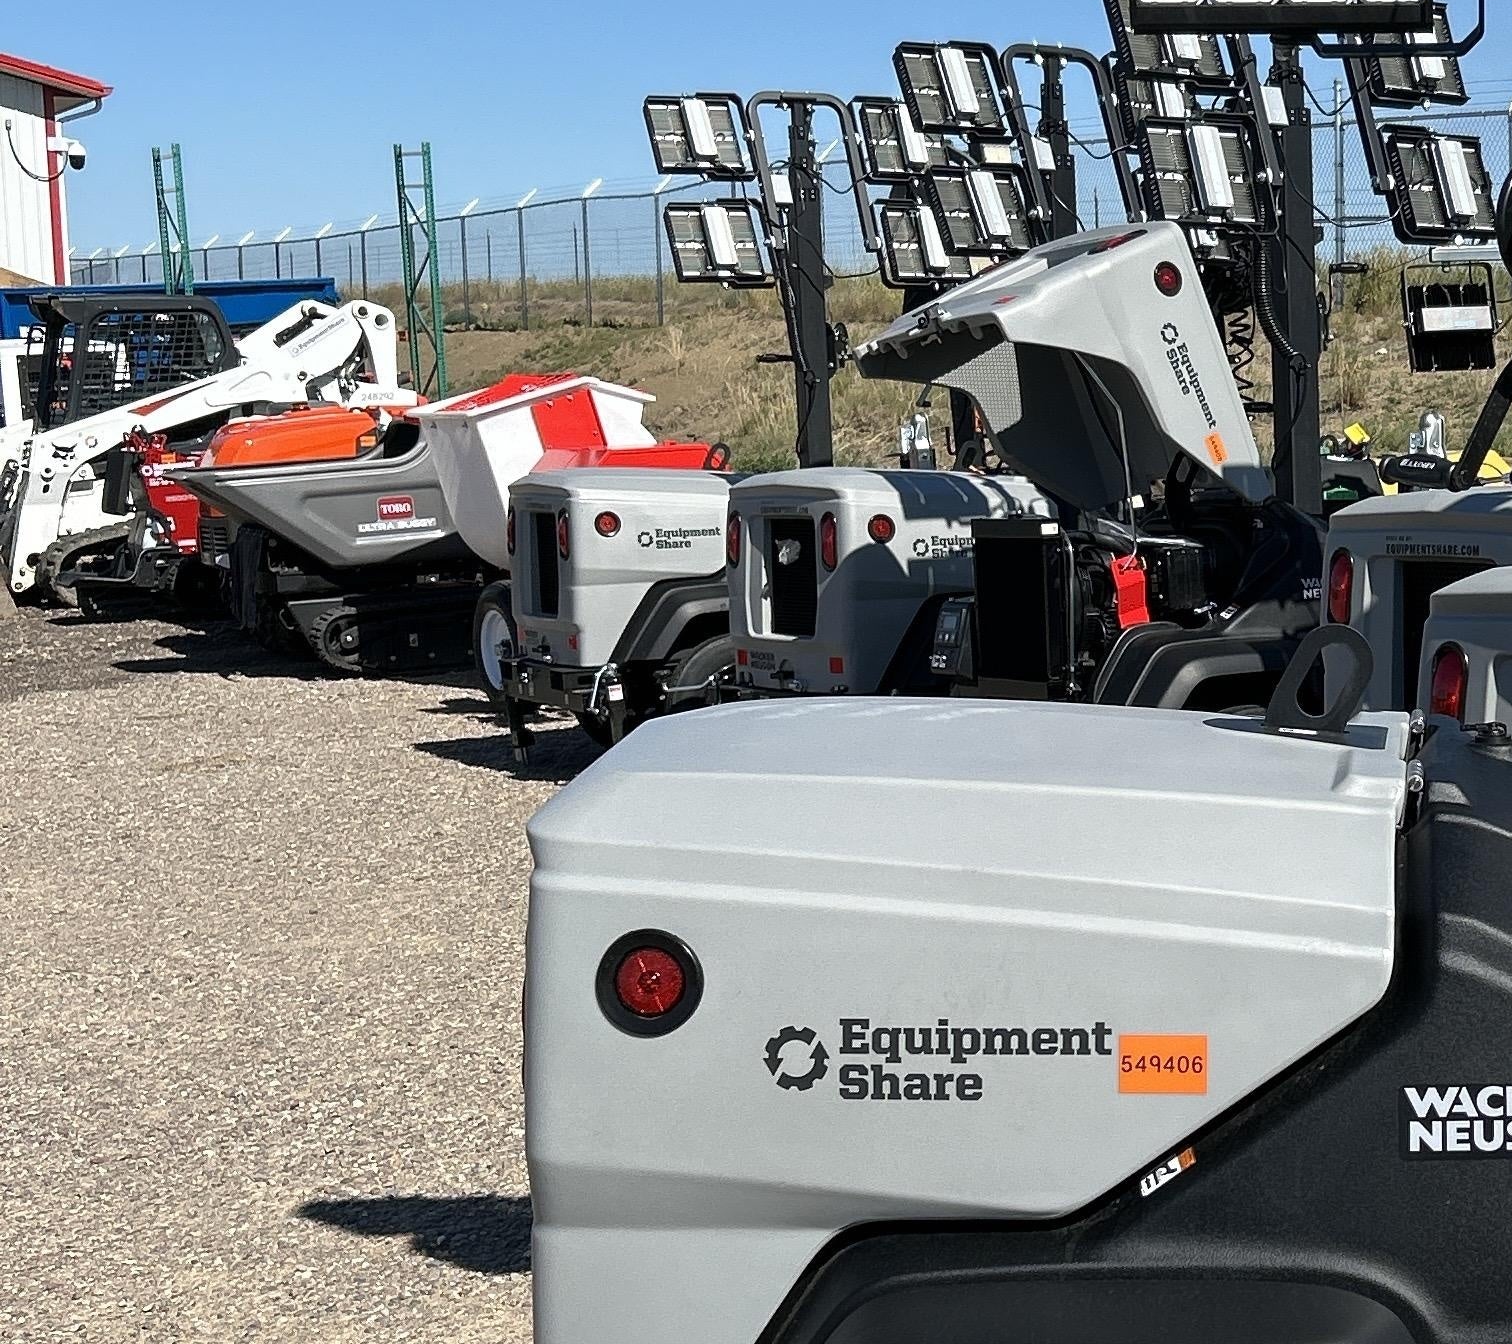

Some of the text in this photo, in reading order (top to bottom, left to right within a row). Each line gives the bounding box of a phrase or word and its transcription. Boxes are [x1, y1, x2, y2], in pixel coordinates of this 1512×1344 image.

[1166, 348, 1190, 396] Share
[1177, 342, 1217, 429] Equipment
[380, 502, 412, 515] TORO
[655, 526, 721, 540] Equipment
[656, 539, 692, 549] Share
[839, 1018, 1112, 1063] Equipment
[1120, 1055, 1203, 1074] 549406
[839, 1064, 983, 1101] Share
